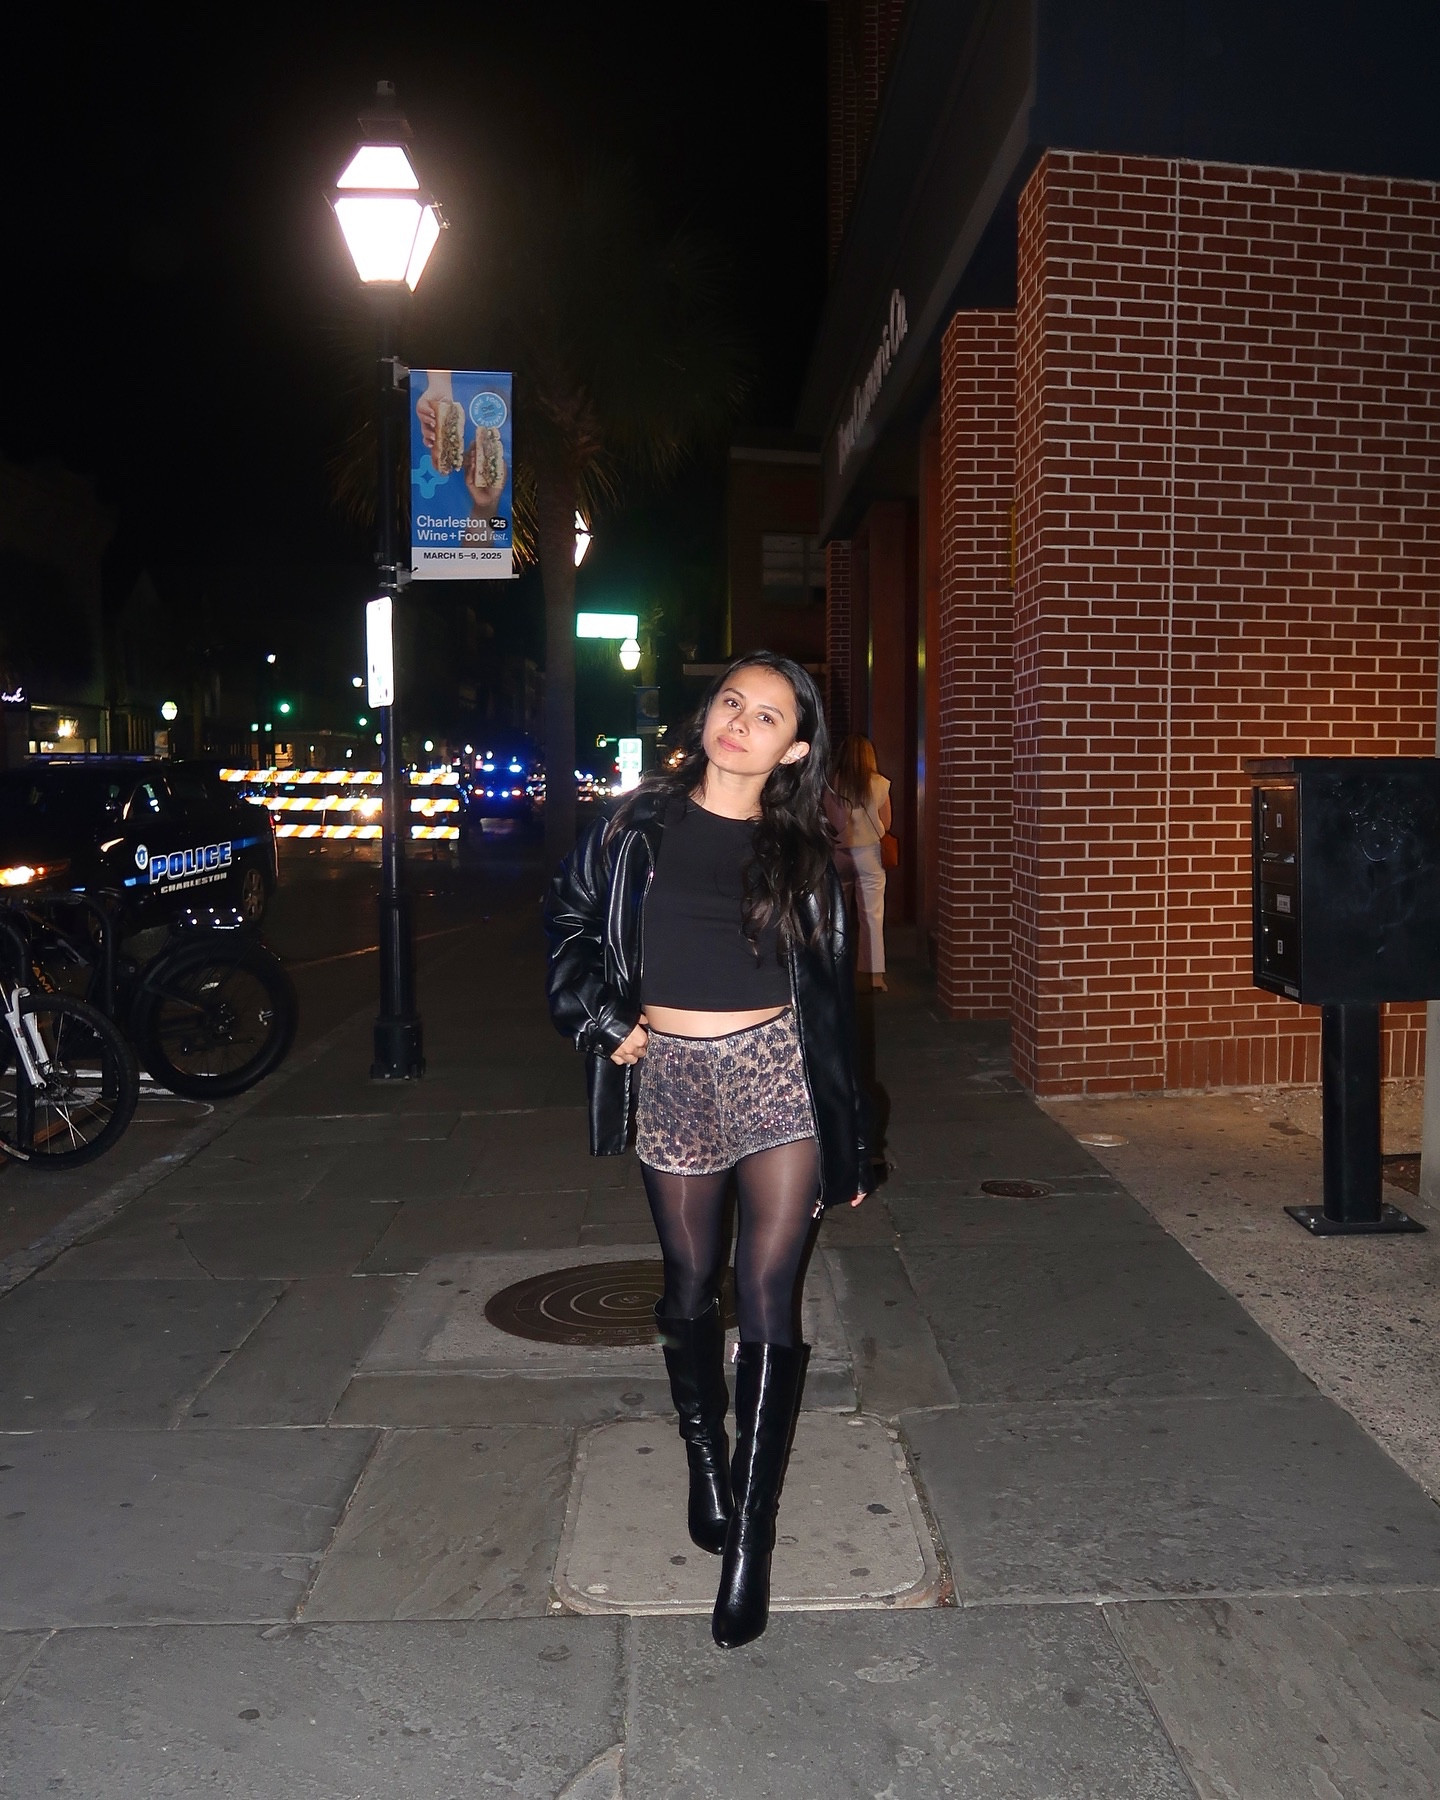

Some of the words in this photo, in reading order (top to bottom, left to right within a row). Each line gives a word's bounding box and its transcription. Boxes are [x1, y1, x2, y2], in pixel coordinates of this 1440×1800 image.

[417, 515, 487, 528] Charleston
[490, 518, 507, 529] '25
[489, 530, 508, 541] fest.
[423, 552, 456, 560] MARCH
[481, 552, 502, 560] 2025
[149, 841, 233, 885] POLICE
[160, 871, 228, 894] CHARLESTON
